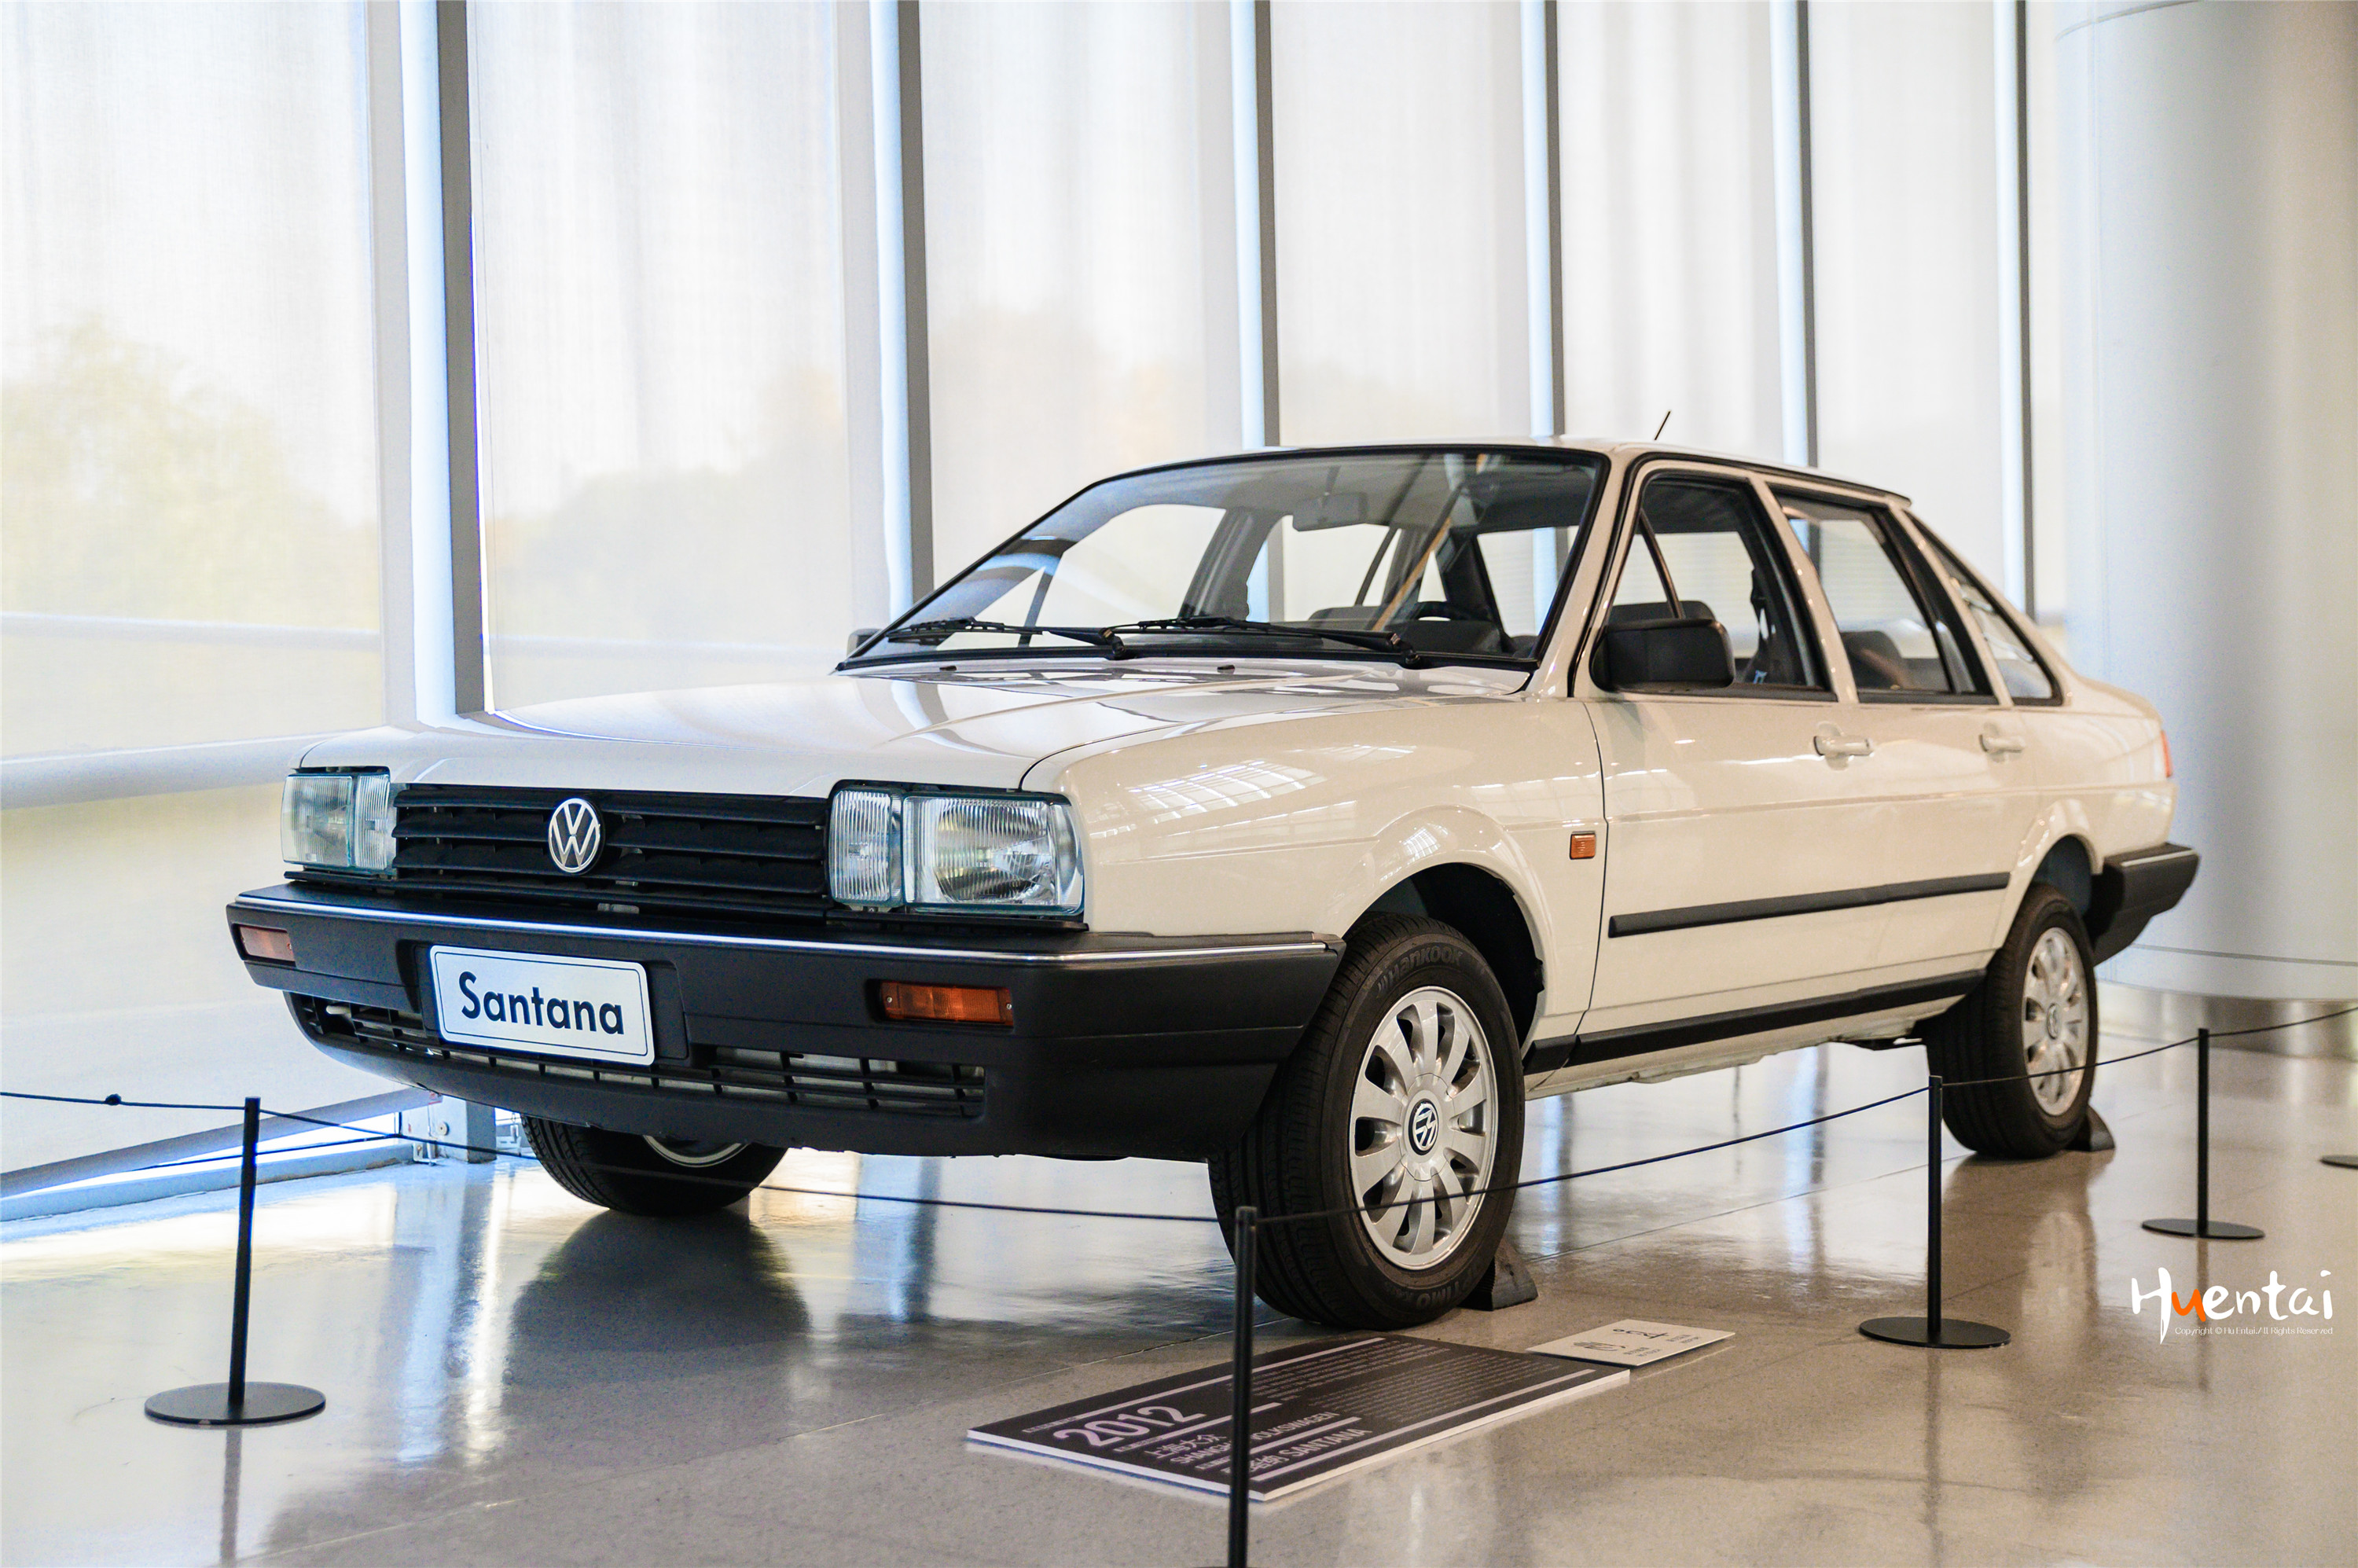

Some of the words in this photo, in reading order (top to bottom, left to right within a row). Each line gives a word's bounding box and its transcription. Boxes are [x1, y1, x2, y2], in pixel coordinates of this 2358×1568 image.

[549, 798, 601, 872] VW
[458, 971, 625, 1035] Santana
[1052, 1405, 1207, 1447] 2012
[1144, 1434, 1227, 1458] 上海大众
[1279, 1428, 1373, 1457] SANTANA
